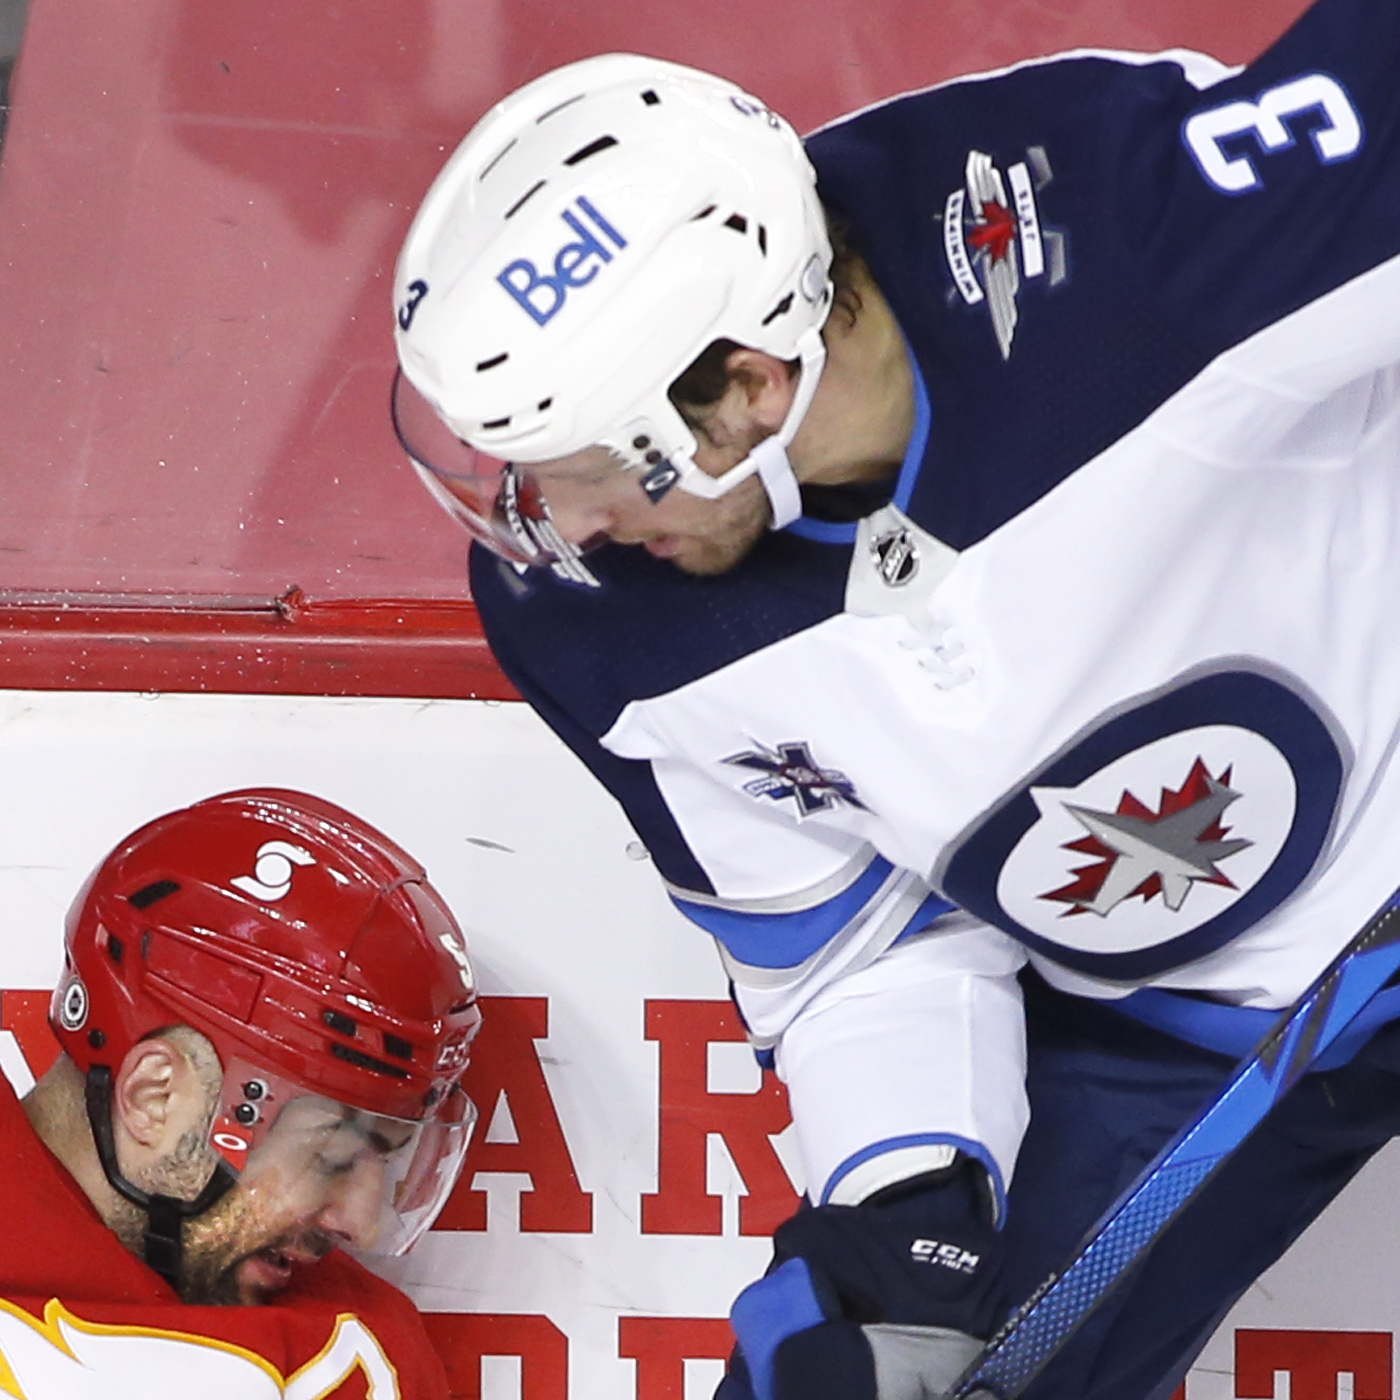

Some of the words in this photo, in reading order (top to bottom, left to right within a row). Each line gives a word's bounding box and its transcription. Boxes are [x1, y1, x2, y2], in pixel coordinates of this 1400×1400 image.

[1183, 70, 1363, 196] 3
[496, 195, 628, 327] Bell
[910, 1238, 981, 1268] CCM
